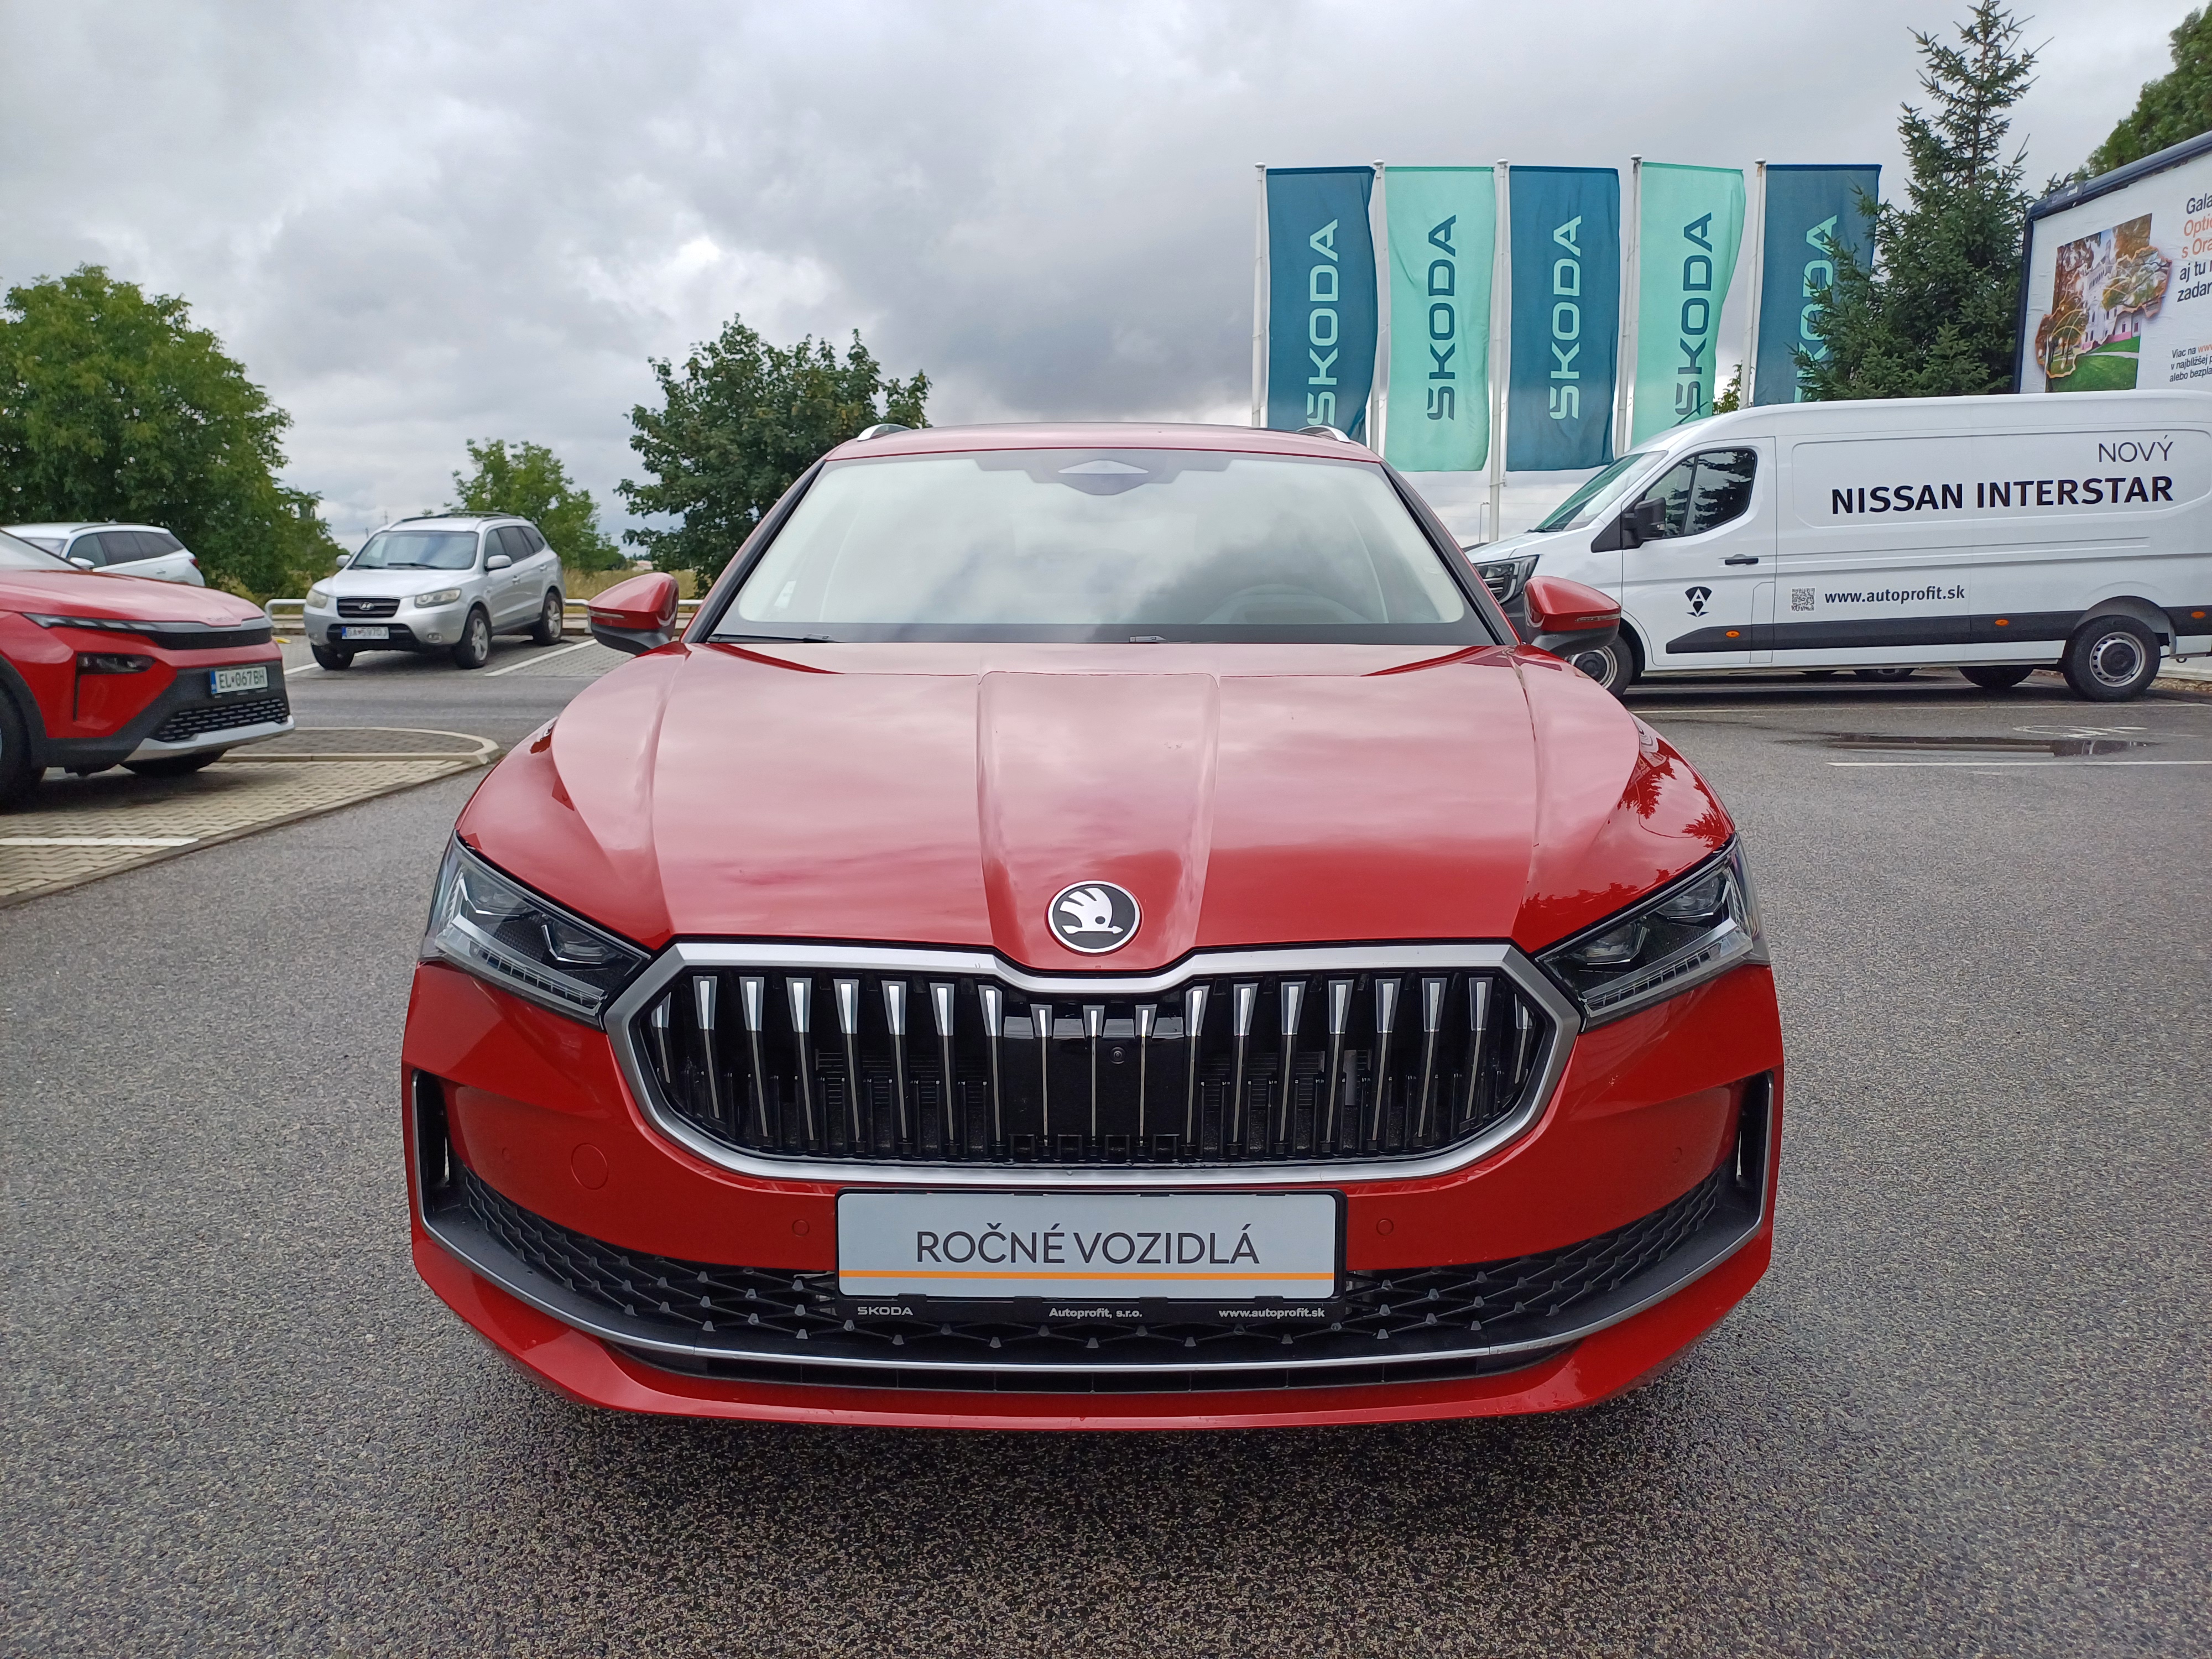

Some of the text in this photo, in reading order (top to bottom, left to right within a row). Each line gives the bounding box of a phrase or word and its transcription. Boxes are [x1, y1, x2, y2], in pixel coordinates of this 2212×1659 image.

[2186, 193, 2212, 215] Gala
[2182, 247, 2188, 258] s
[2179, 262, 2190, 283] aj
[2194, 261, 2206, 276] tu
[2172, 348, 2186, 358] Viac
[2169, 371, 2188, 382] alebo
[2098, 435, 2173, 463] NOVÝ
[1832, 476, 2173, 514] NISSAN INTERSTAR
[1824, 585, 1965, 604] www.autoprofit.sk
[916, 1223, 1260, 1265] ROČNÉ VOZIDLÁ
[1048, 1307, 1113, 1319] Autoprofit,
[1218, 1307, 1326, 1319] www.autoprofit.sk
